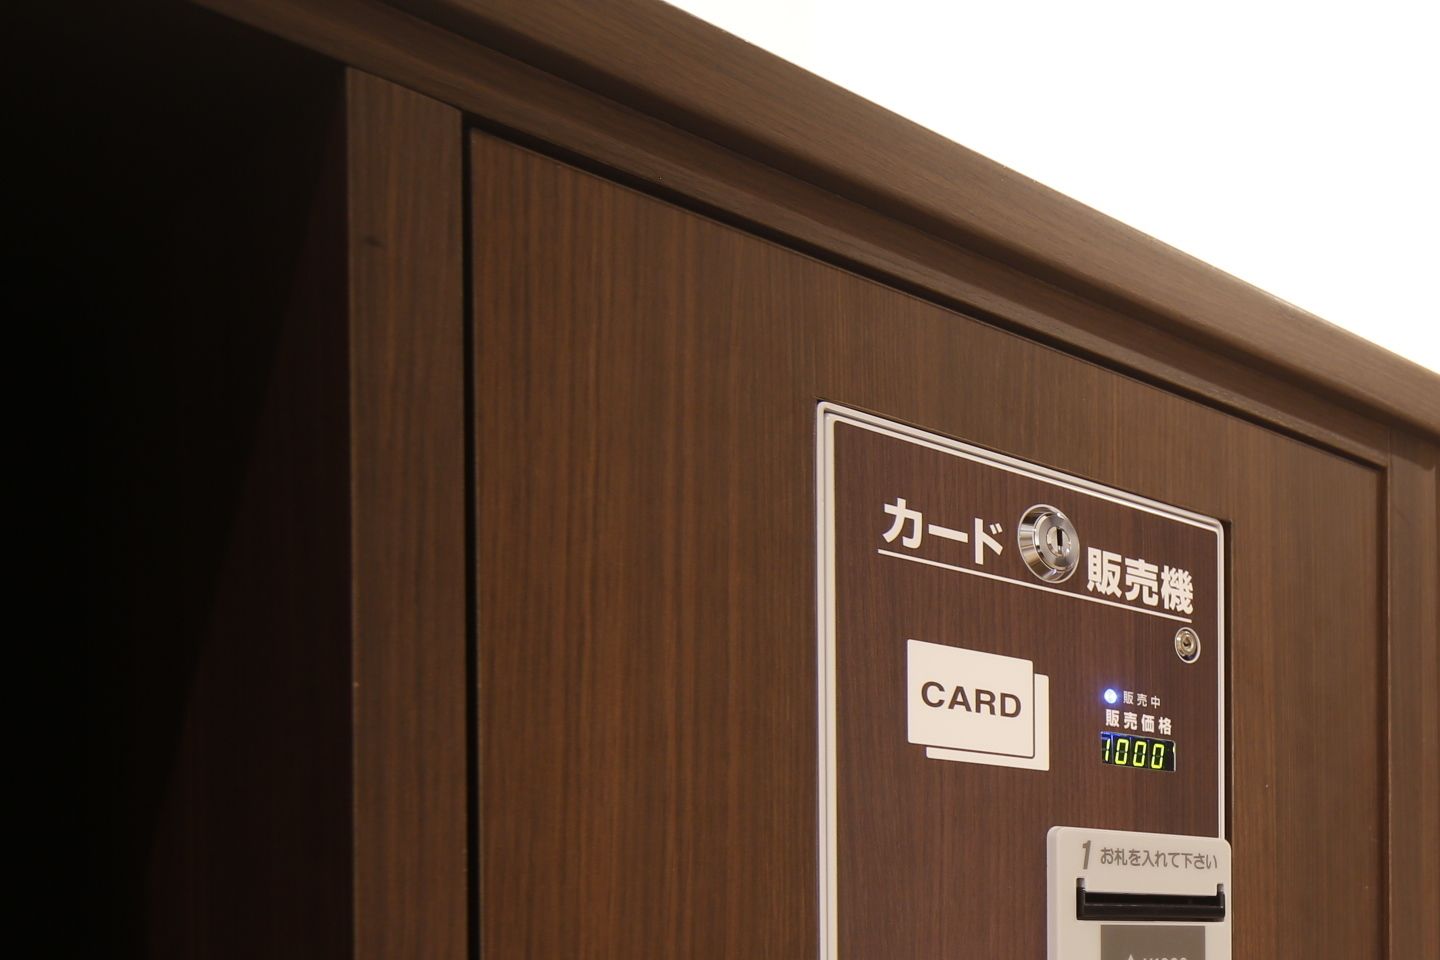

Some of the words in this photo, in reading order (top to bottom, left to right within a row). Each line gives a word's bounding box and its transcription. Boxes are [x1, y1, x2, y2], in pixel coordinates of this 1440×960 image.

[883, 497, 1004, 565] カード
[1086, 546, 1194, 614] 販売機
[921, 681, 1022, 719] CARD
[1123, 690, 1161, 709] 販売中
[1105, 709, 1172, 735] 販売価格
[1104, 738, 1165, 770] 1000
[1100, 847, 1218, 870] お札を入れて下さい
